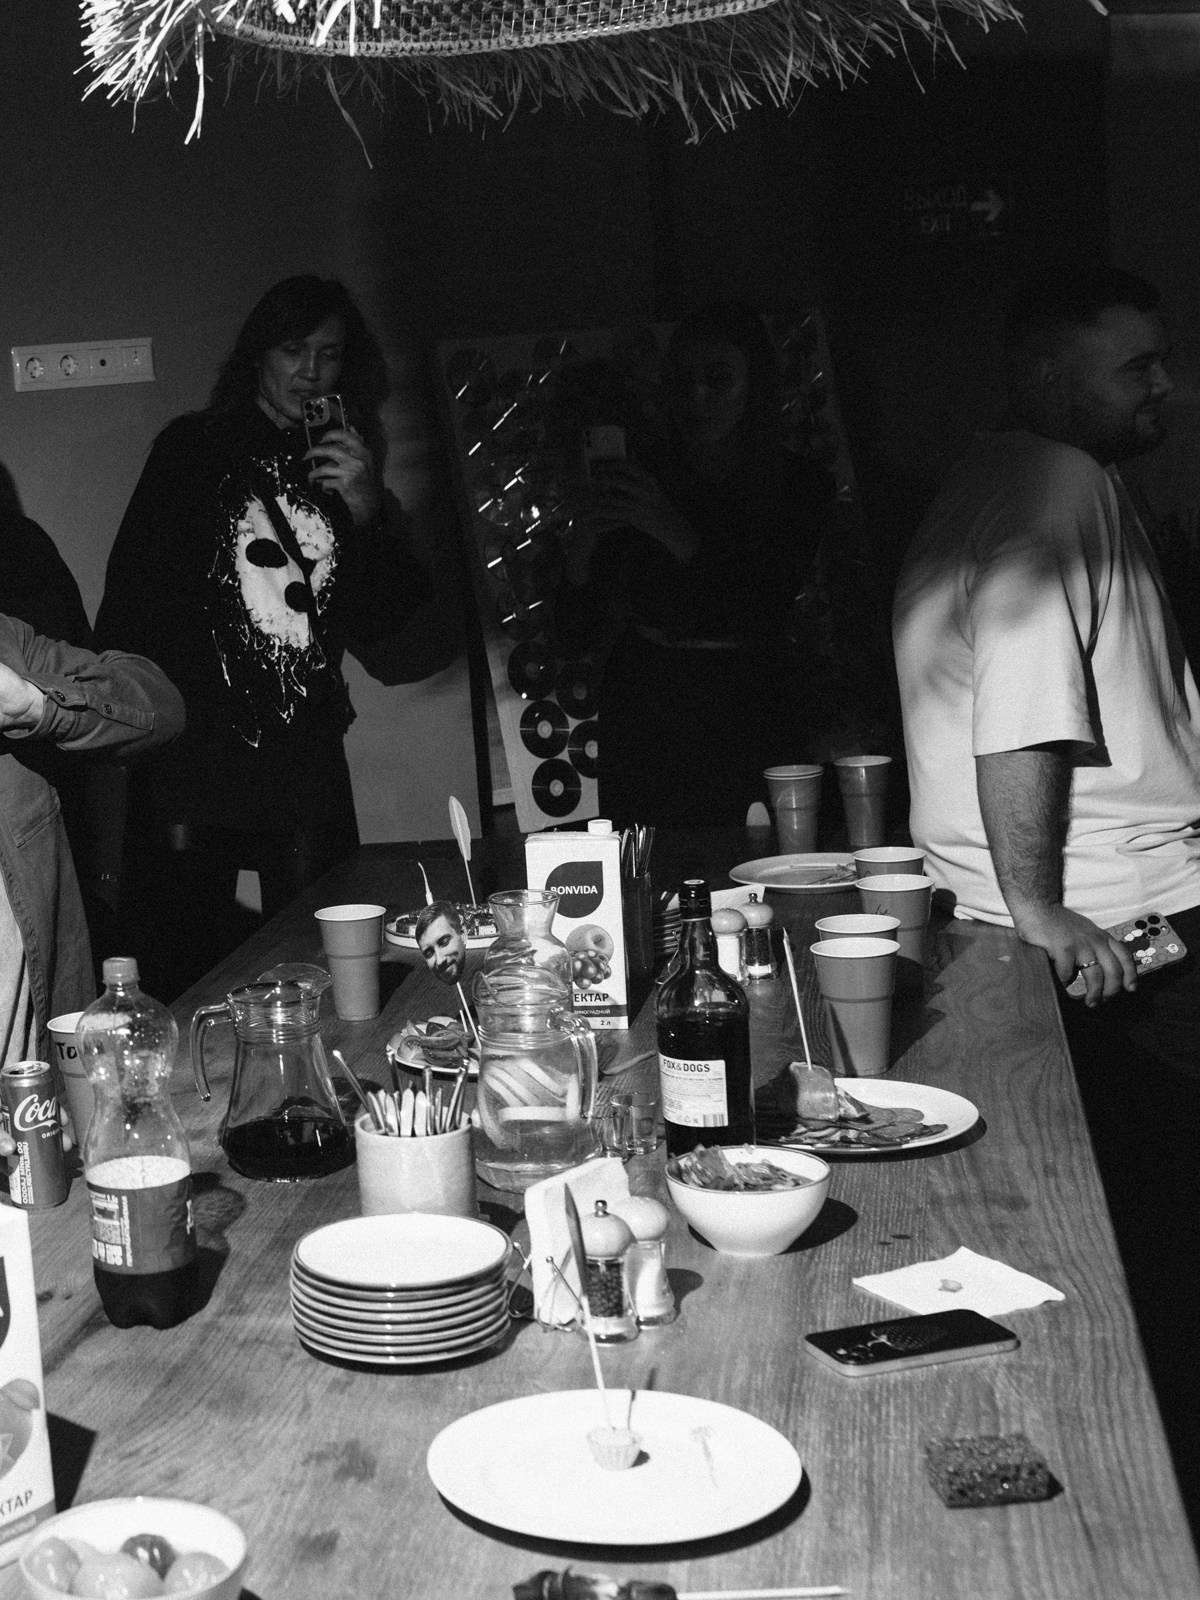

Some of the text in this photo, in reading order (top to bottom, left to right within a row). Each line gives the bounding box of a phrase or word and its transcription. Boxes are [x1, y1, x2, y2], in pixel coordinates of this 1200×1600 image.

[550, 885, 598, 895] BONVIDA
[574, 992, 610, 1003] ЕКТАР
[14, 1093, 57, 1132] Coca
